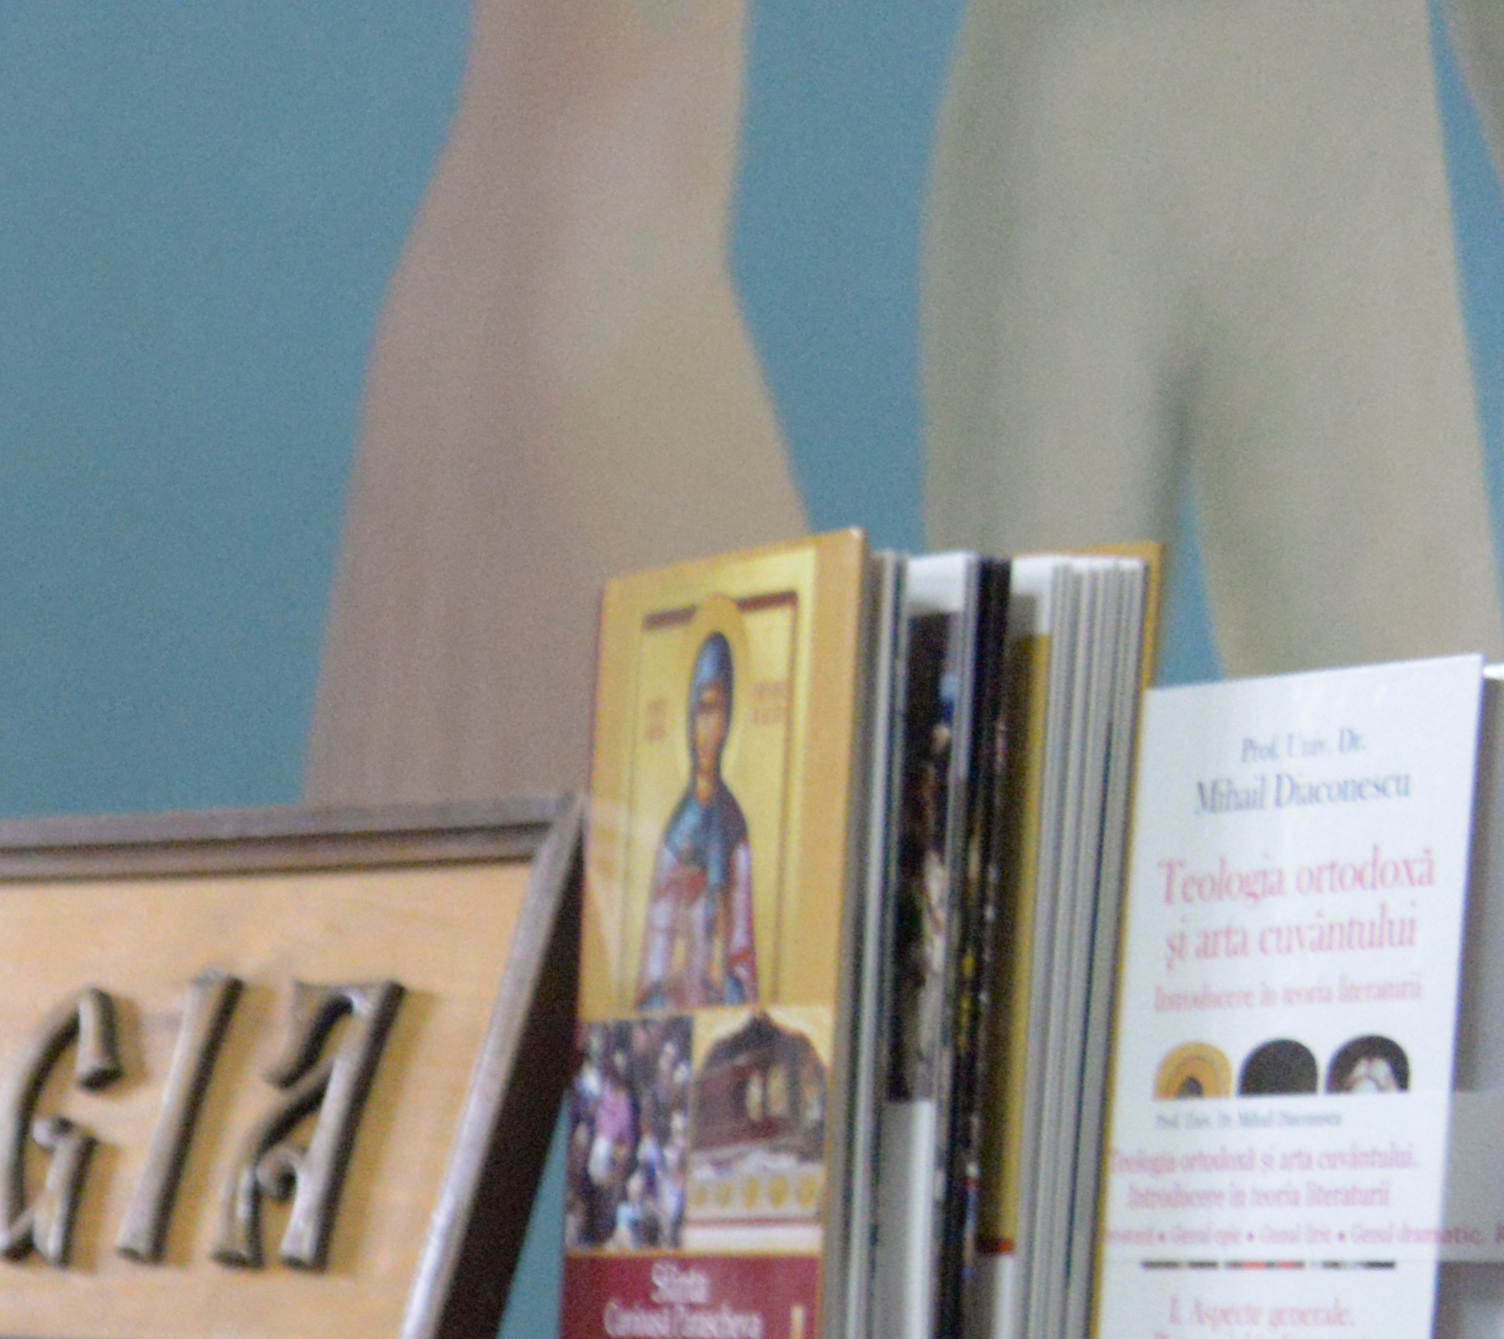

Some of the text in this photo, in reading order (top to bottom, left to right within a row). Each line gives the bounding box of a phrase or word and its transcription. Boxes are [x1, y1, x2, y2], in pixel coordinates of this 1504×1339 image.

[1194, 772, 1411, 815] Mihail Diaconescu
[1157, 844, 1436, 909] Teologia ortodoxă
[1194, 924, 1250, 961] arta
[1258, 902, 1418, 954] cuvântului
